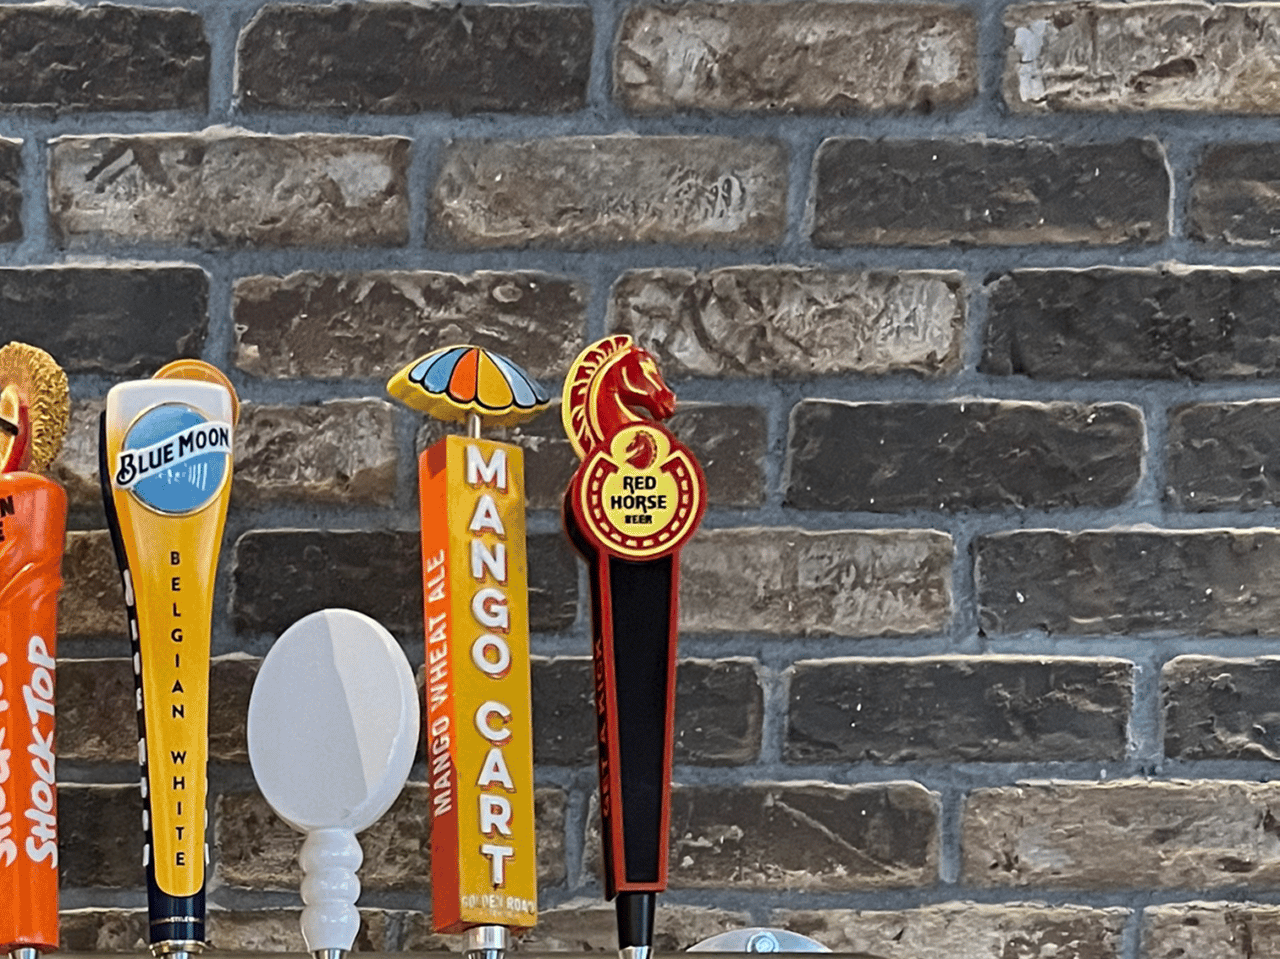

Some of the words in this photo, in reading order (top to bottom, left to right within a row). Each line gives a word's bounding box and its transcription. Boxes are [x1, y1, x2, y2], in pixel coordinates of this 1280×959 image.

[117, 445, 175, 485] BLUE
[178, 427, 231, 456] MOON
[610, 495, 667, 513] HORSE
[623, 476, 657, 494] RED
[466, 445, 511, 677] MANGO
[624, 515, 653, 524] BEER
[427, 549, 446, 604] ALE
[22, 634, 56, 725] TOP
[171, 551, 185, 720] BELGIAN
[431, 611, 449, 710] WHEAT
[24, 726, 58, 869] SHOCK
[170, 751, 187, 866] WHITE
[433, 715, 453, 818] MANGO
[474, 700, 517, 888] CART
